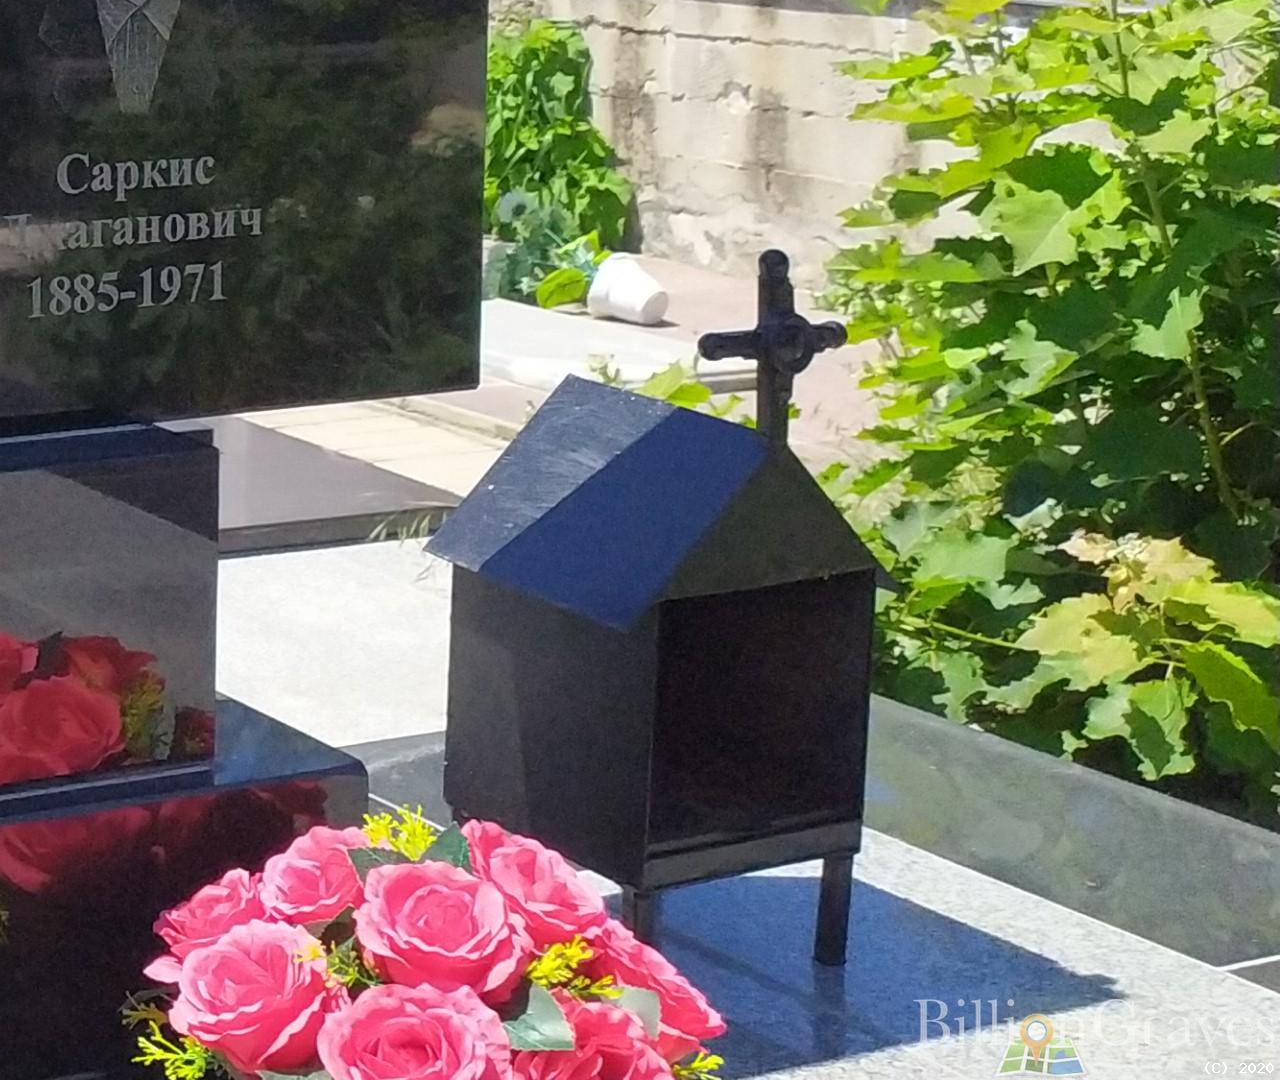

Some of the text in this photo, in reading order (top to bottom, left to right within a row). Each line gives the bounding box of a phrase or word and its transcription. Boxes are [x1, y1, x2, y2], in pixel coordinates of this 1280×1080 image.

[56, 152, 217, 202] Саркис
[3, 206, 262, 256] Даганович
[27, 260, 228, 319] 1885-1971
